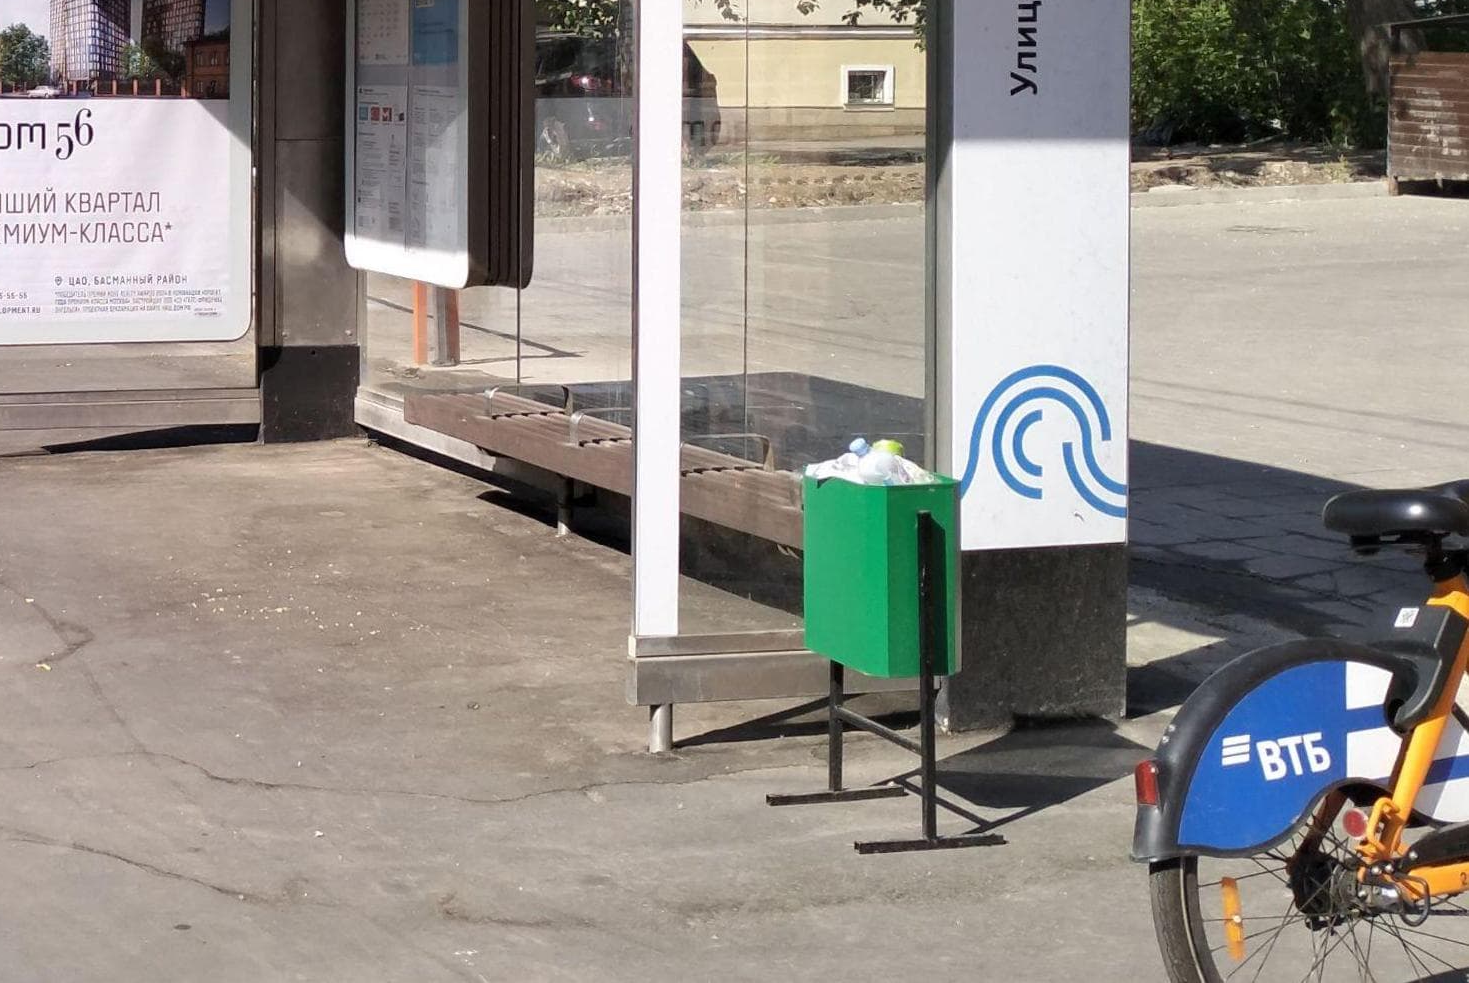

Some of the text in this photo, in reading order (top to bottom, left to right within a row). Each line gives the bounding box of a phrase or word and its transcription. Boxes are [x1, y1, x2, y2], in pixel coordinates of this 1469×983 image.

[55, 108, 94, 160] 56
[65, 191, 160, 213] КВАРТАЛ
[68, 273, 188, 287] ЦАО, БАСМАННЫЙ РАЙОН
[1256, 732, 1331, 781] ВТБ
